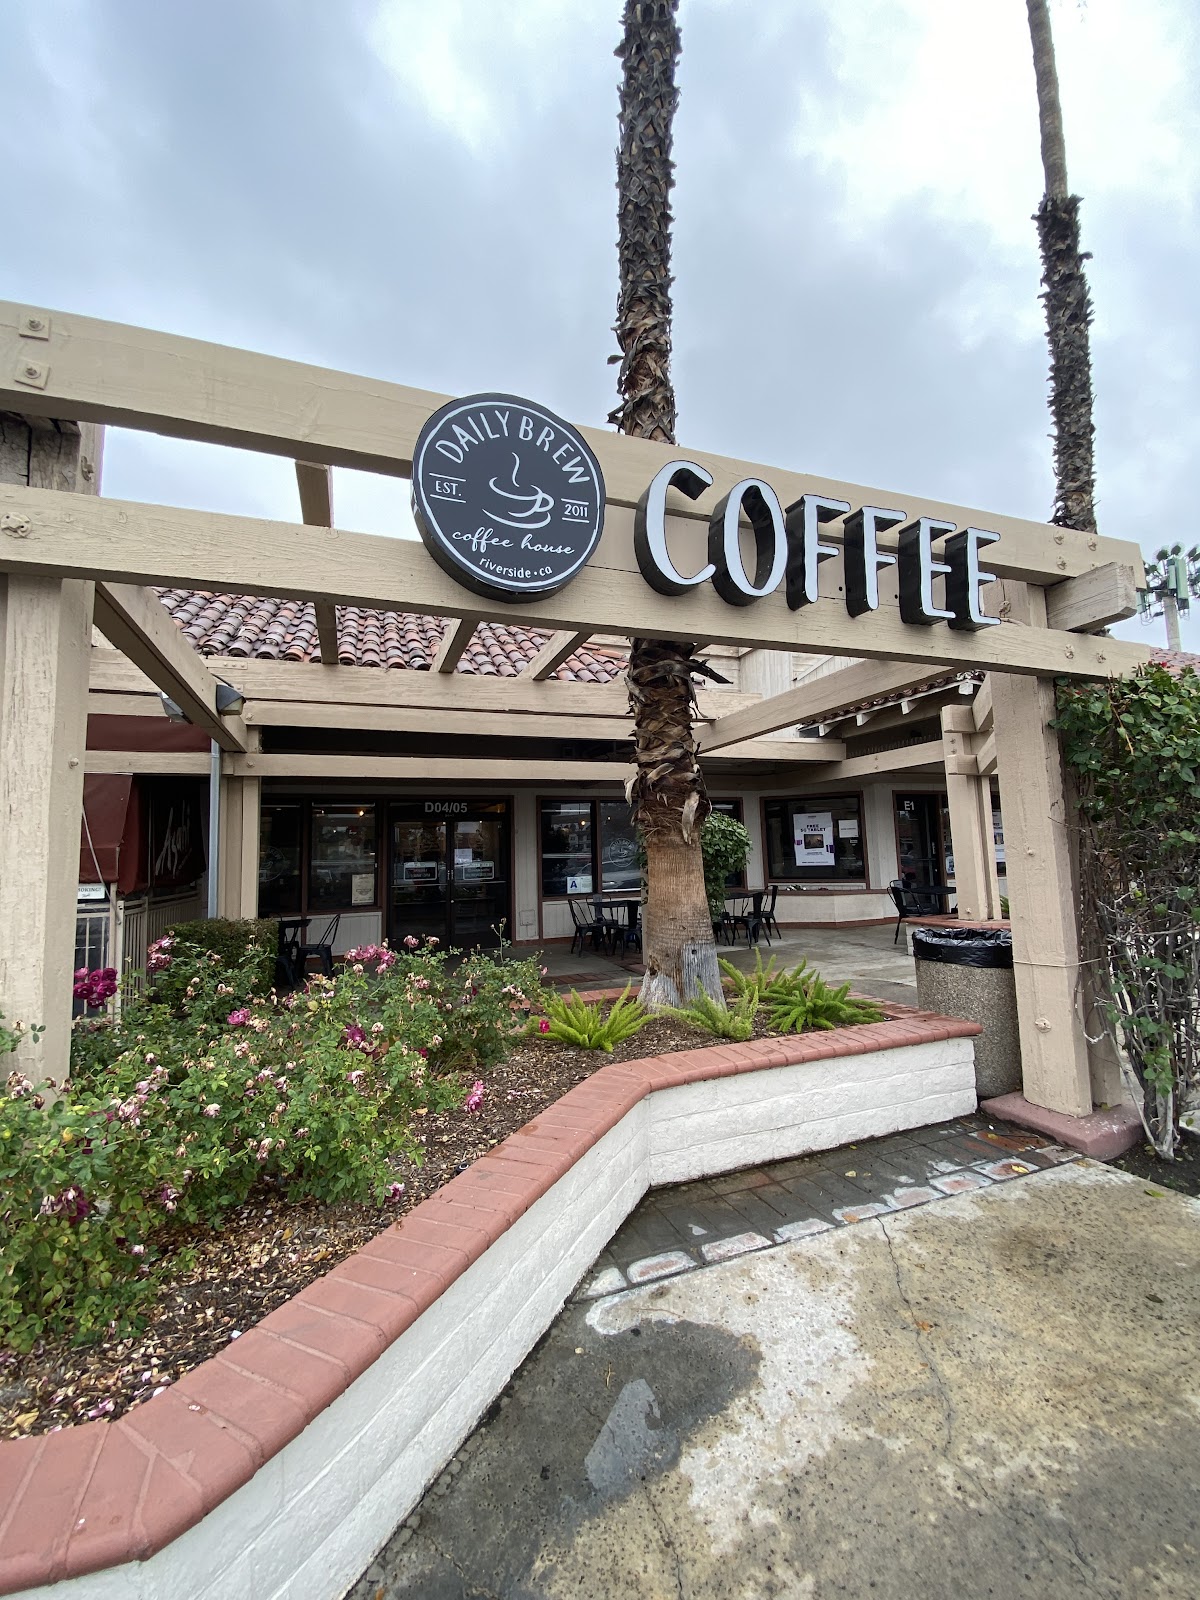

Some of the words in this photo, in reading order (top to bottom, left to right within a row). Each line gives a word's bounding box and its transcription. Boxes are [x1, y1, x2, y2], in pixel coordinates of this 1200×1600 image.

[435, 410, 509, 464] DAILY
[518, 415, 590, 484] BREW
[435, 480, 462, 497] EST.
[564, 504, 588, 518] 2011
[452, 526, 514, 553] coffee
[520, 533, 575, 555] house
[642, 459, 1002, 626] COFFEE
[424, 801, 468, 813] D04/05
[903, 800, 915, 811] E1
[570, 880, 578, 889] A
